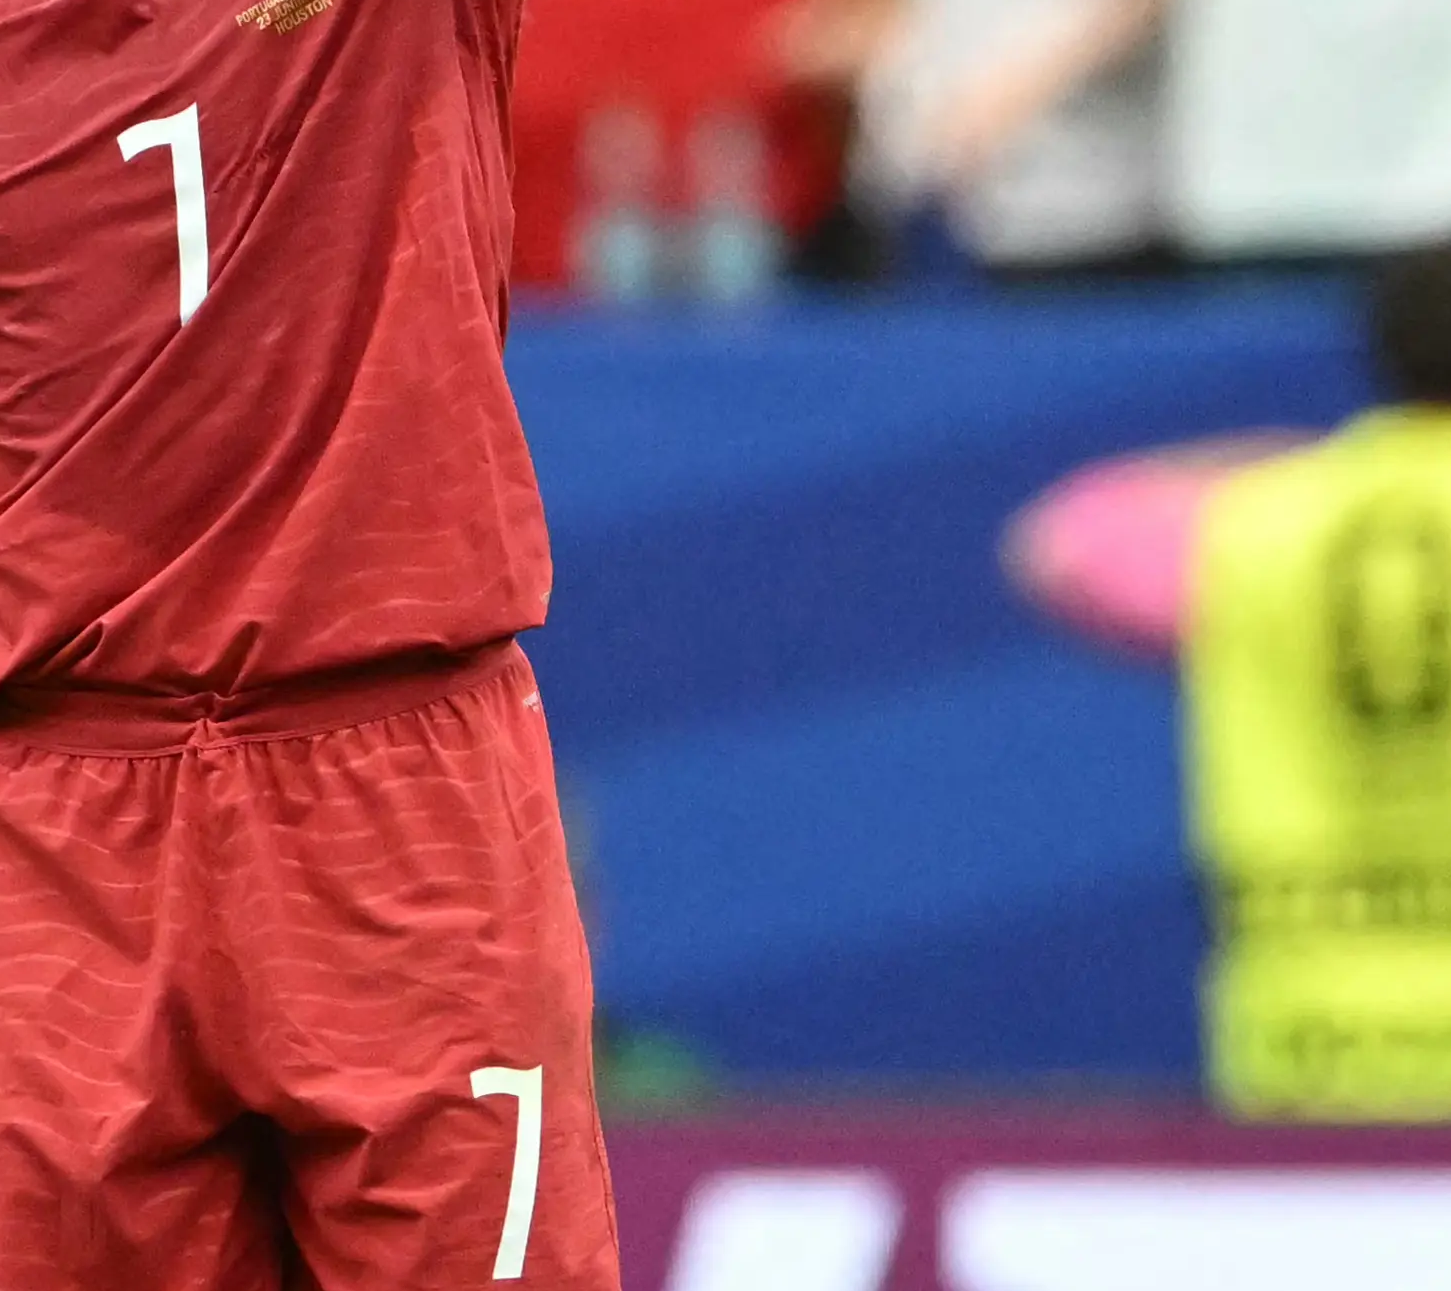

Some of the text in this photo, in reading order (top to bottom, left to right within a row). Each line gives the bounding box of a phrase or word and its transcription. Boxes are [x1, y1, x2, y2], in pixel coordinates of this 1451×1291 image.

[256, 13, 272, 30] 23
[116, 102, 209, 327] 7
[469, 1064, 543, 1280] 7
